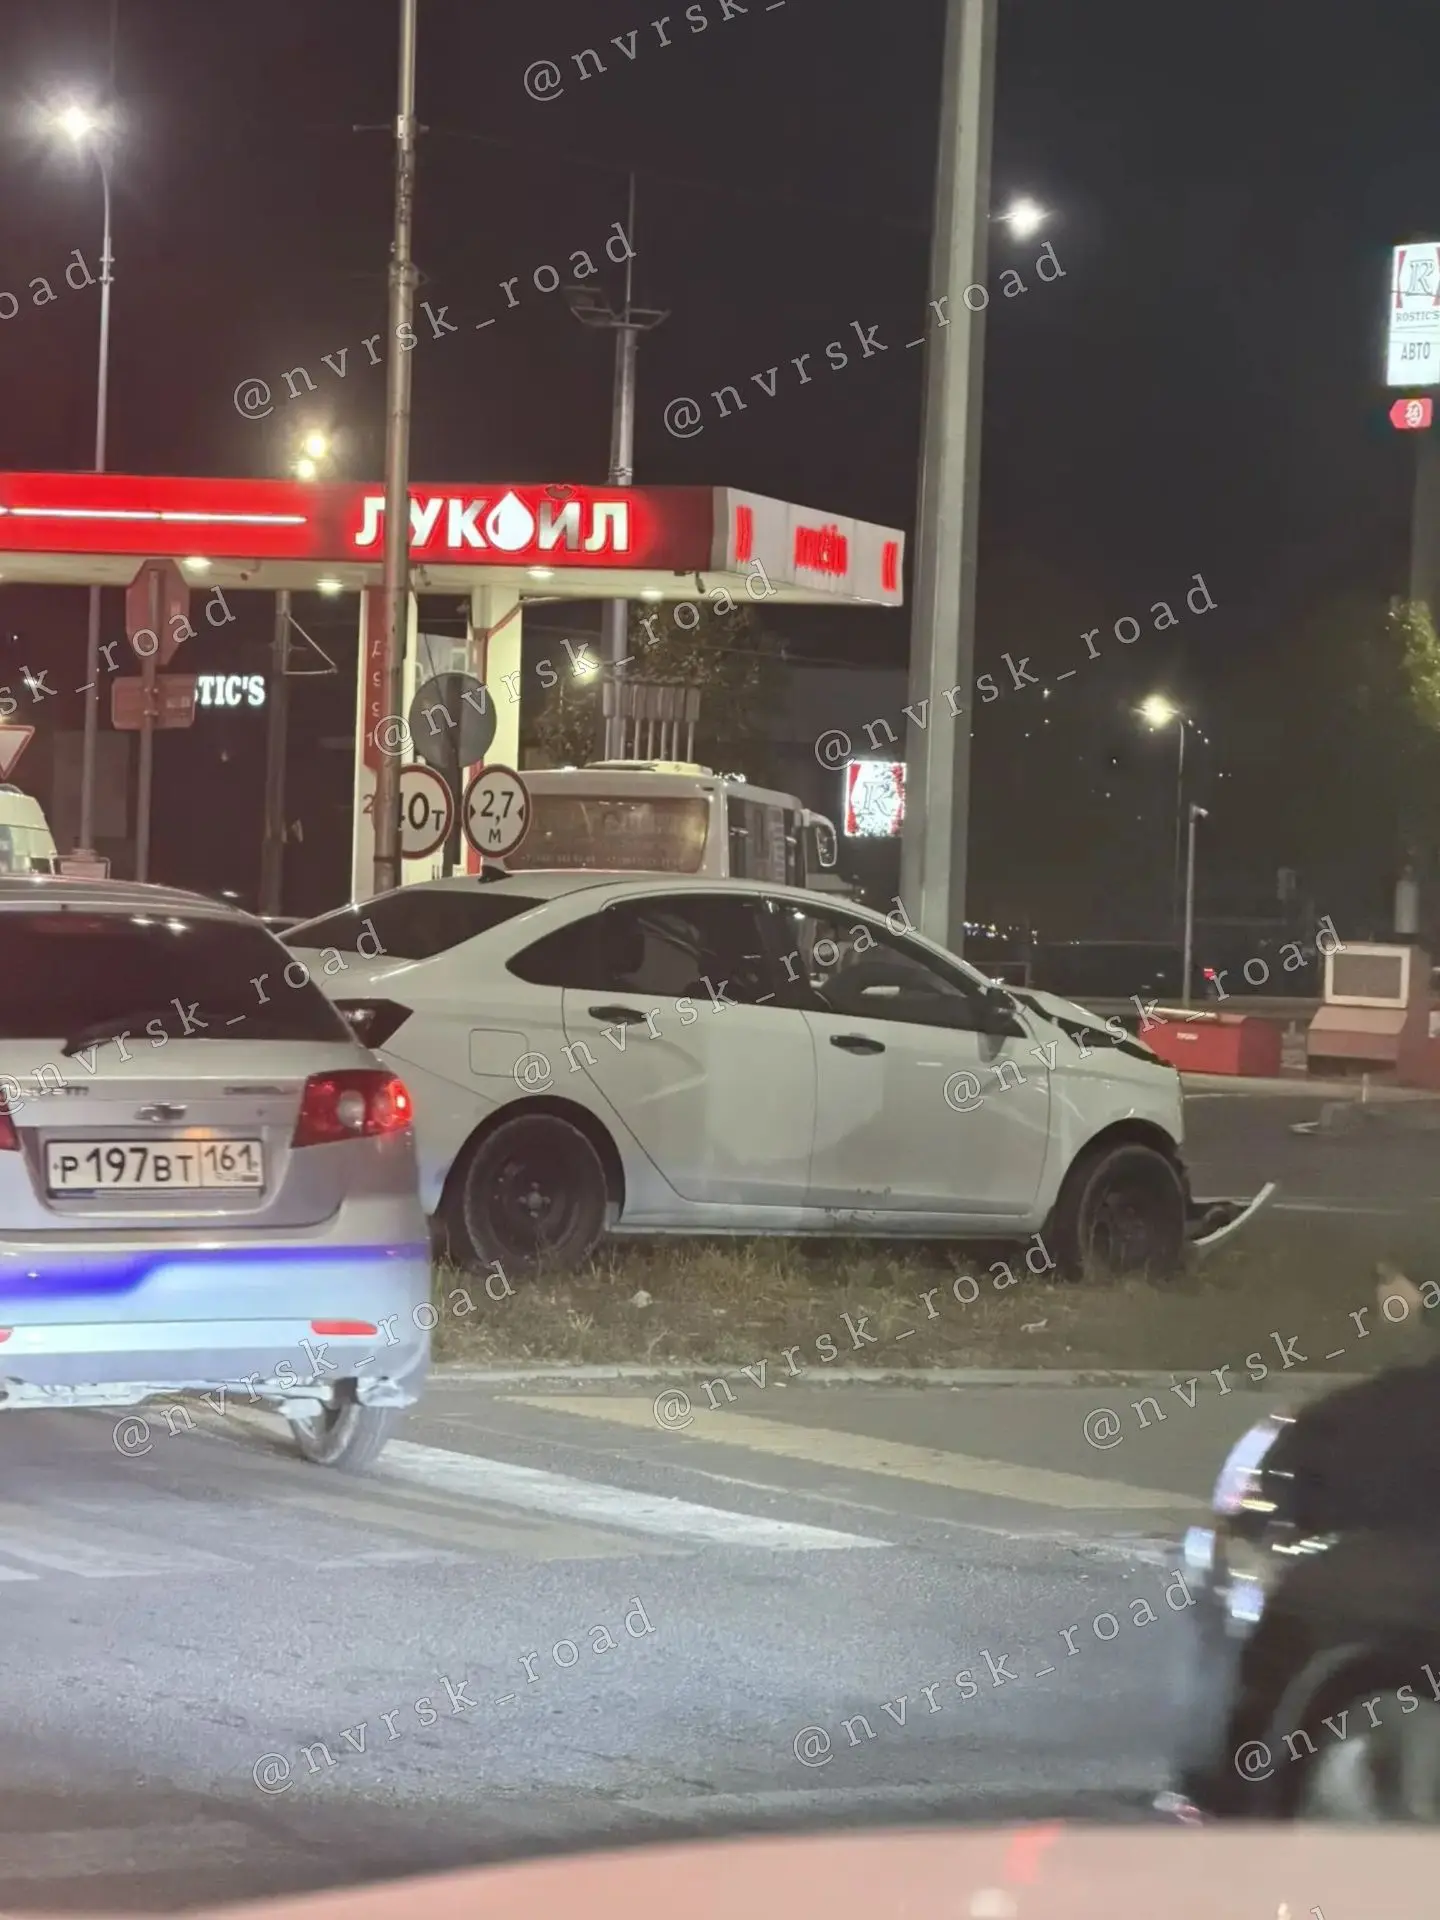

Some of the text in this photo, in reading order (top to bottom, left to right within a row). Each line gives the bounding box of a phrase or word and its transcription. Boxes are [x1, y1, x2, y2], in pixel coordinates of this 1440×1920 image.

[194, 674, 266, 707] TIC'S
[480, 790, 514, 826] 2,7
[204, 1143, 252, 1171] 161
